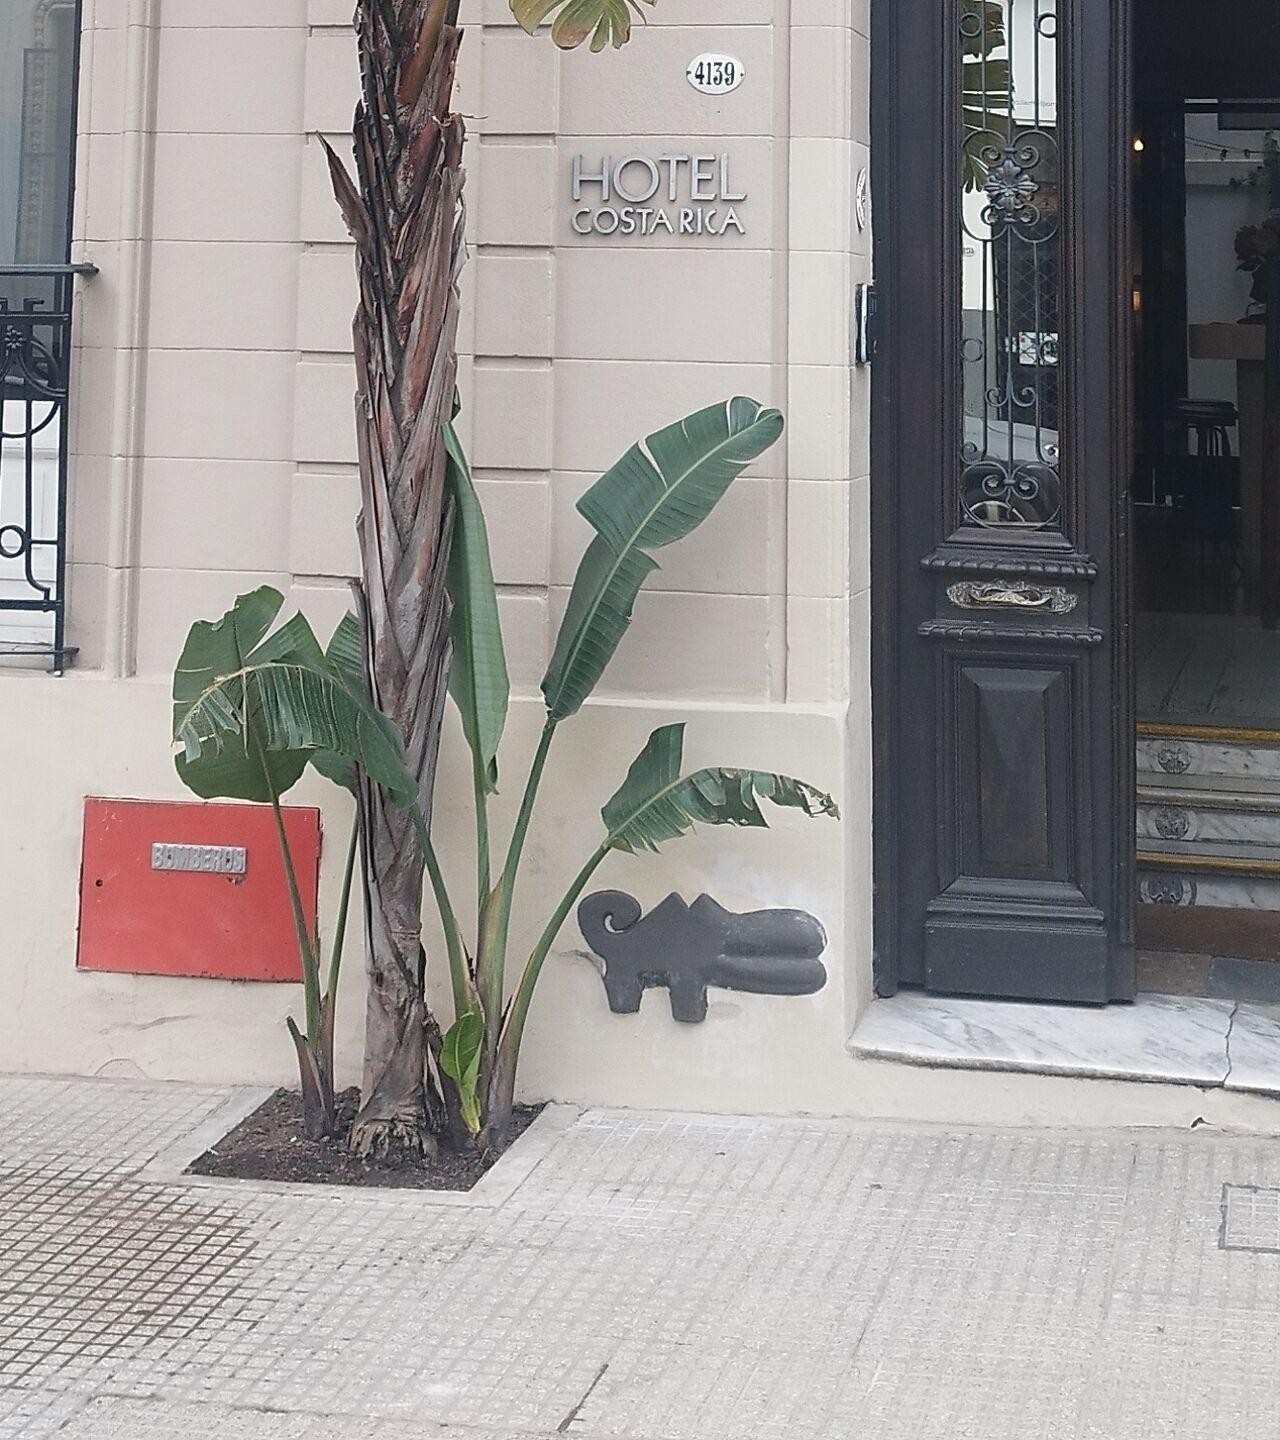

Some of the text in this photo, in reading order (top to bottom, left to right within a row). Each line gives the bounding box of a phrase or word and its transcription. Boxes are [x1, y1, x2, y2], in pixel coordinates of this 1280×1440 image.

[693, 60, 736, 87] 4139
[571, 152, 747, 202] HOTEL
[571, 205, 746, 236] COSTA RICA
[152, 845, 246, 873] BOMBEROS
